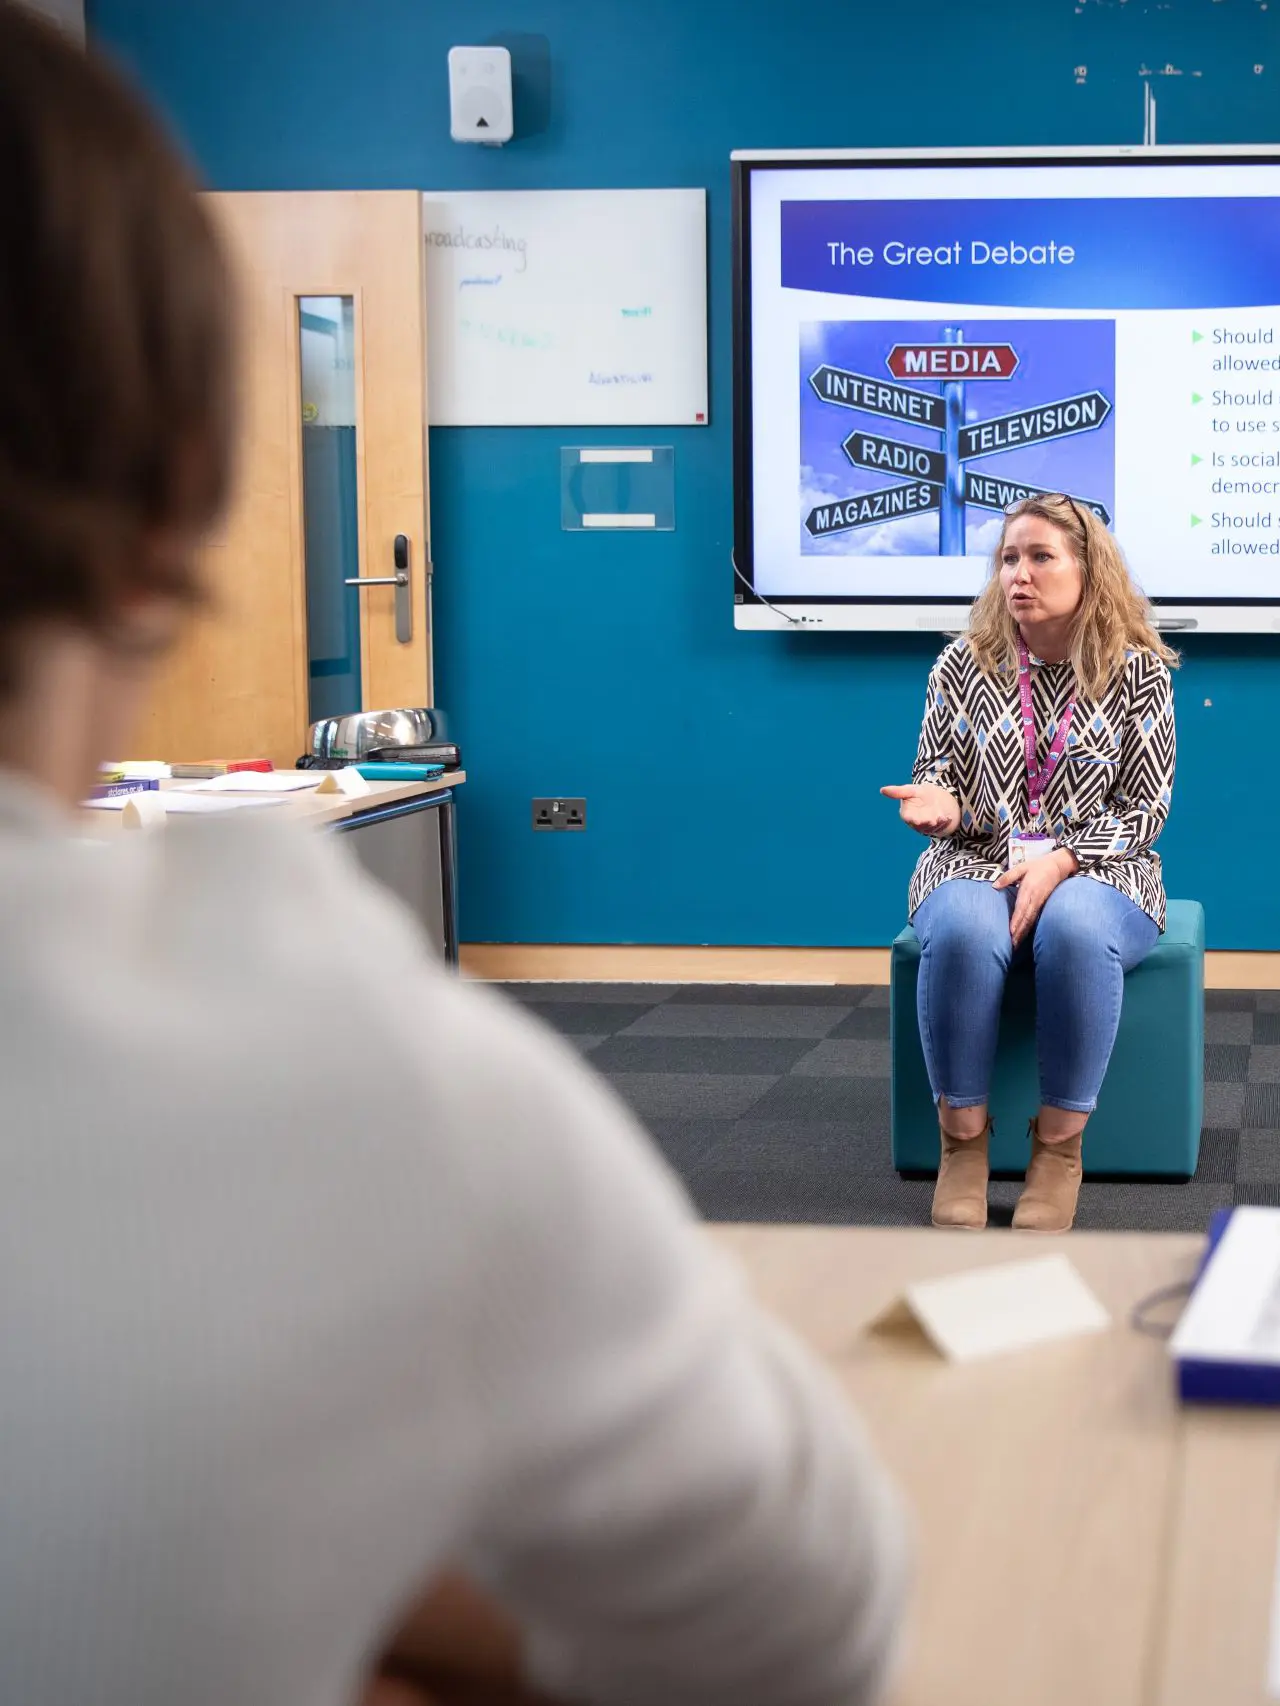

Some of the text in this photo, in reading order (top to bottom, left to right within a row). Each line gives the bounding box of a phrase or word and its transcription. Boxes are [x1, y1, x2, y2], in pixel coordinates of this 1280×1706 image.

[424, 225, 527, 273] roadcasting
[827, 240, 1075, 266] The Great Debate
[1212, 328, 1273, 344] Should
[904, 350, 1002, 373] MEDIA
[826, 373, 935, 421] INTERNET
[1212, 389, 1273, 406] Should
[967, 398, 1097, 452] TELEVISION
[1212, 418, 1230, 433] to
[1236, 420, 1266, 433] use
[862, 438, 931, 475] RADIO
[1211, 451, 1225, 467] Is
[1231, 451, 1280, 467] social
[816, 484, 932, 531] MAGAZINES
[1211, 512, 1271, 528] Should
[1211, 539, 1280, 555] allowed
